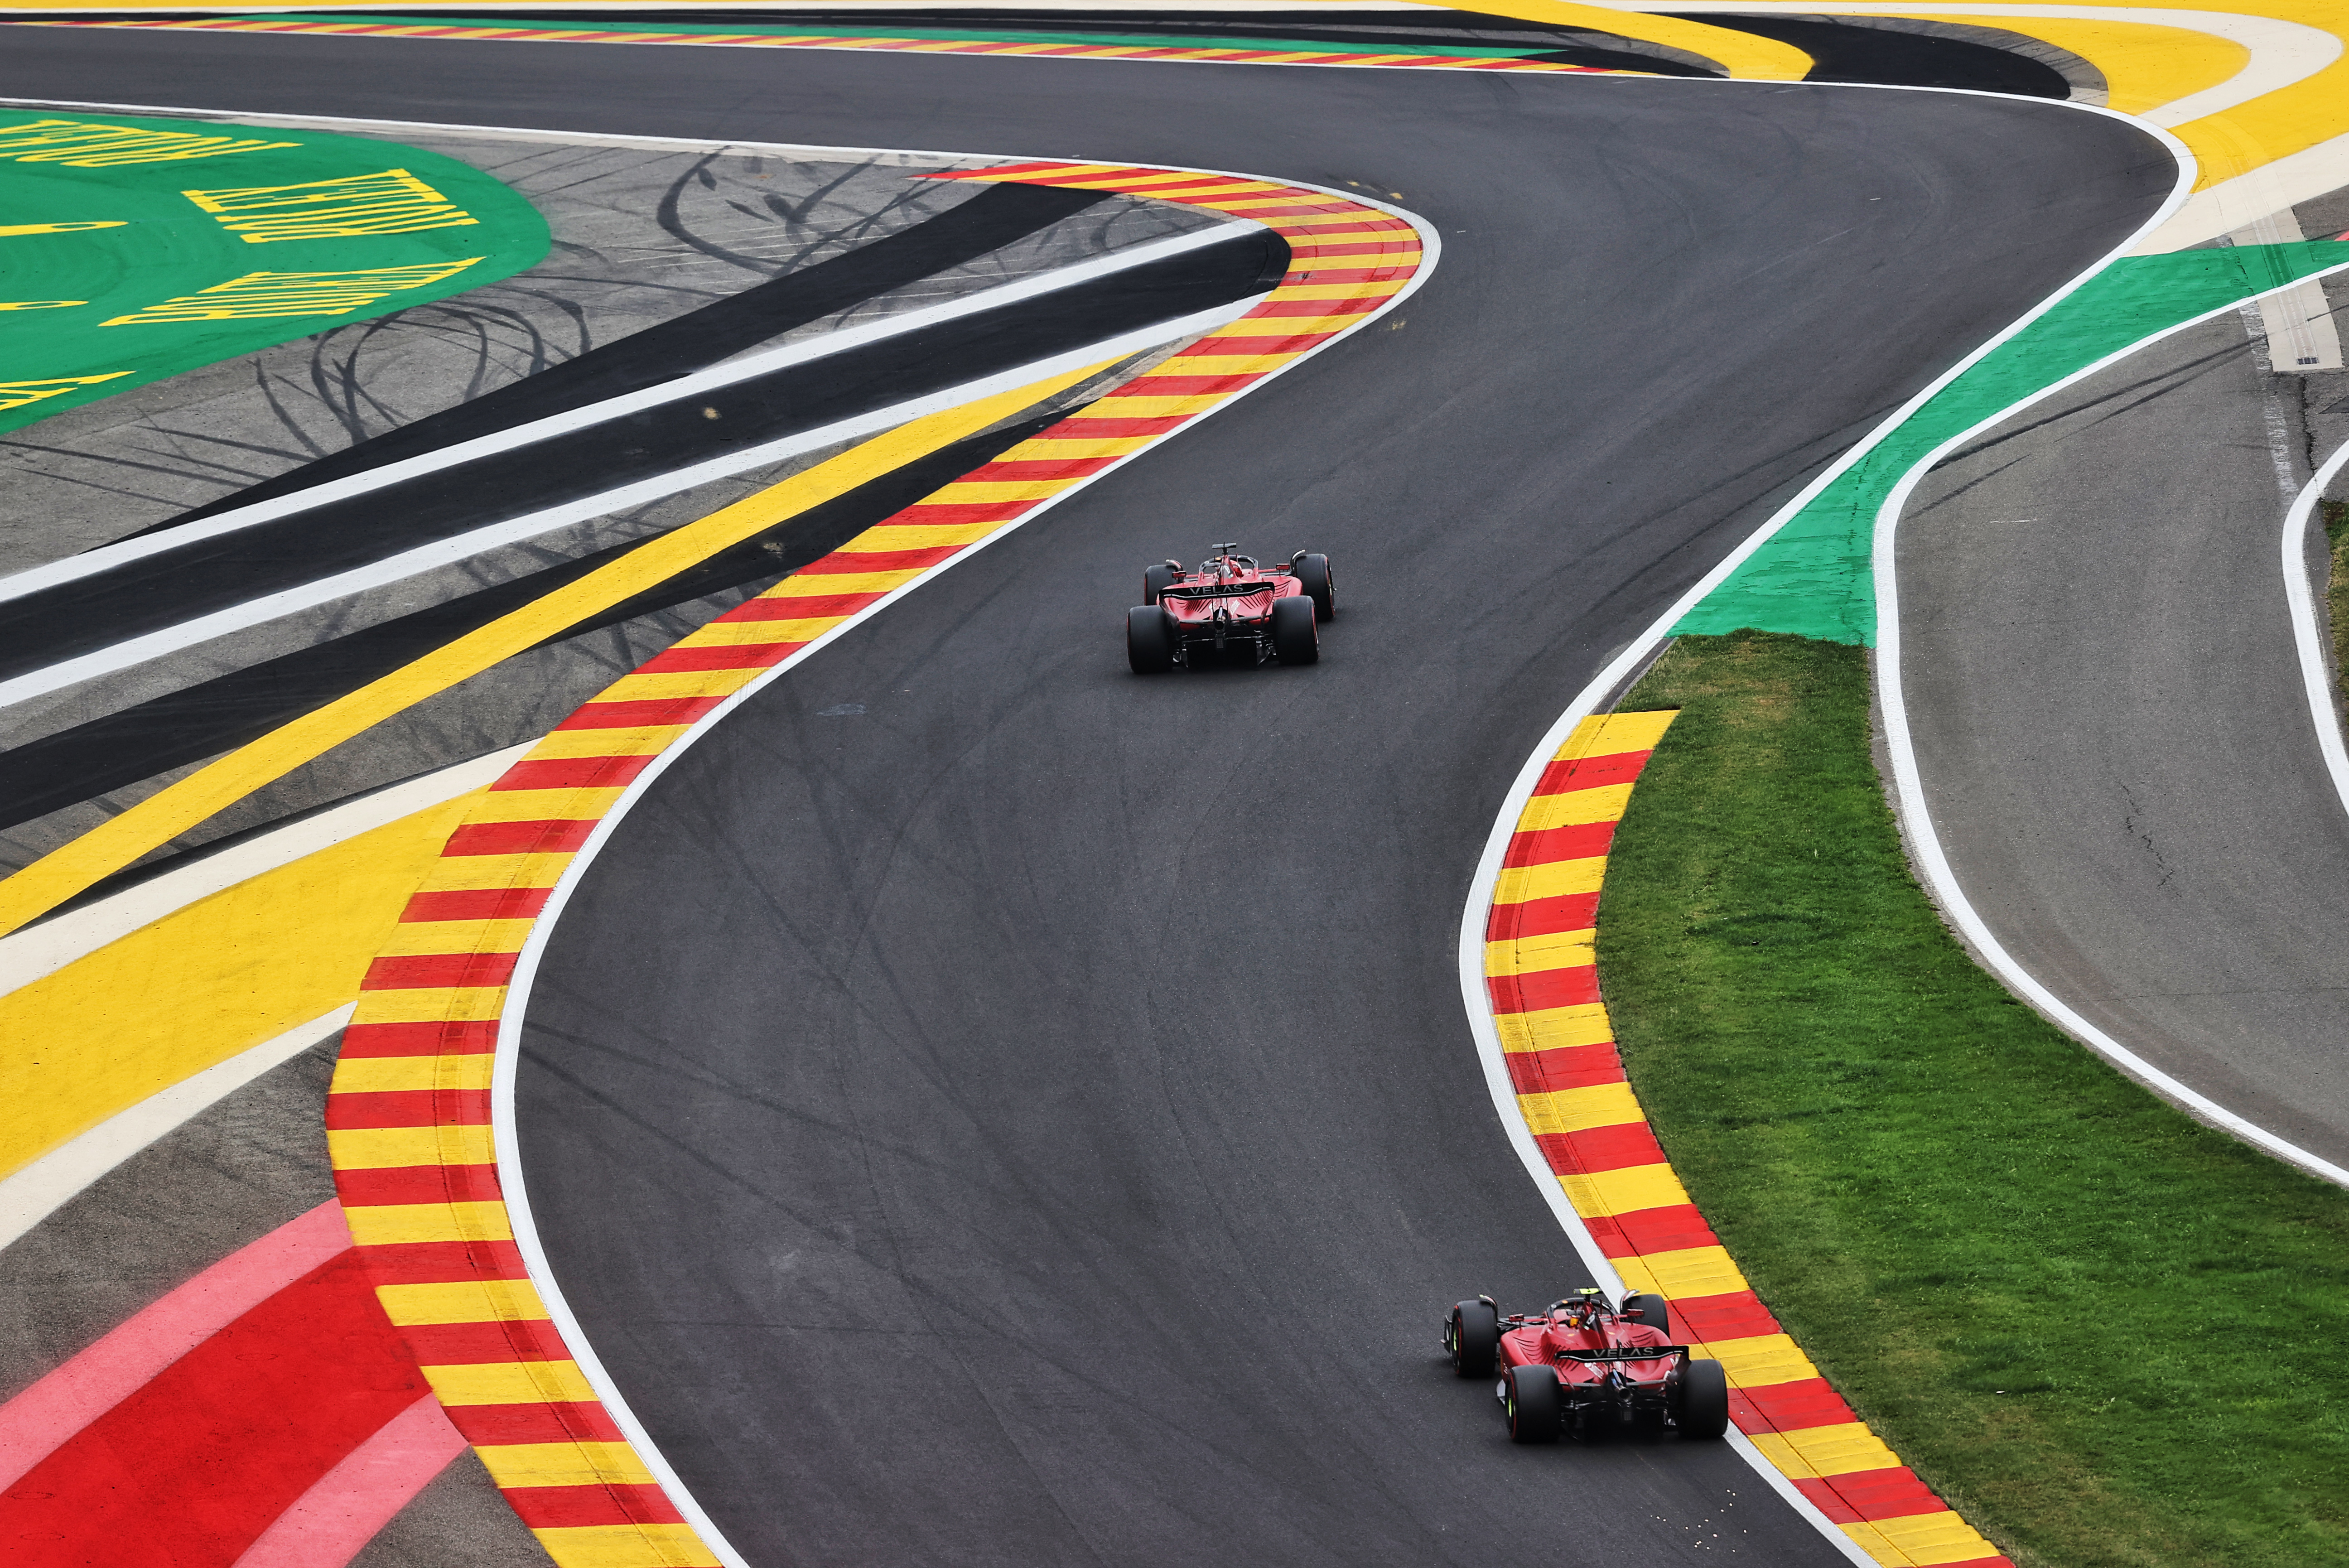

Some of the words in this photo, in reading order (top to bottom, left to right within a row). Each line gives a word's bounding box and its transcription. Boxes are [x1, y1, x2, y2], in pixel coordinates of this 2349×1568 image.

[181, 168, 480, 243] ROLEX
[98, 256, 487, 327] ROLEX
[1190, 584, 1244, 595] VELAS
[1593, 1347, 1654, 1358] VELAS
